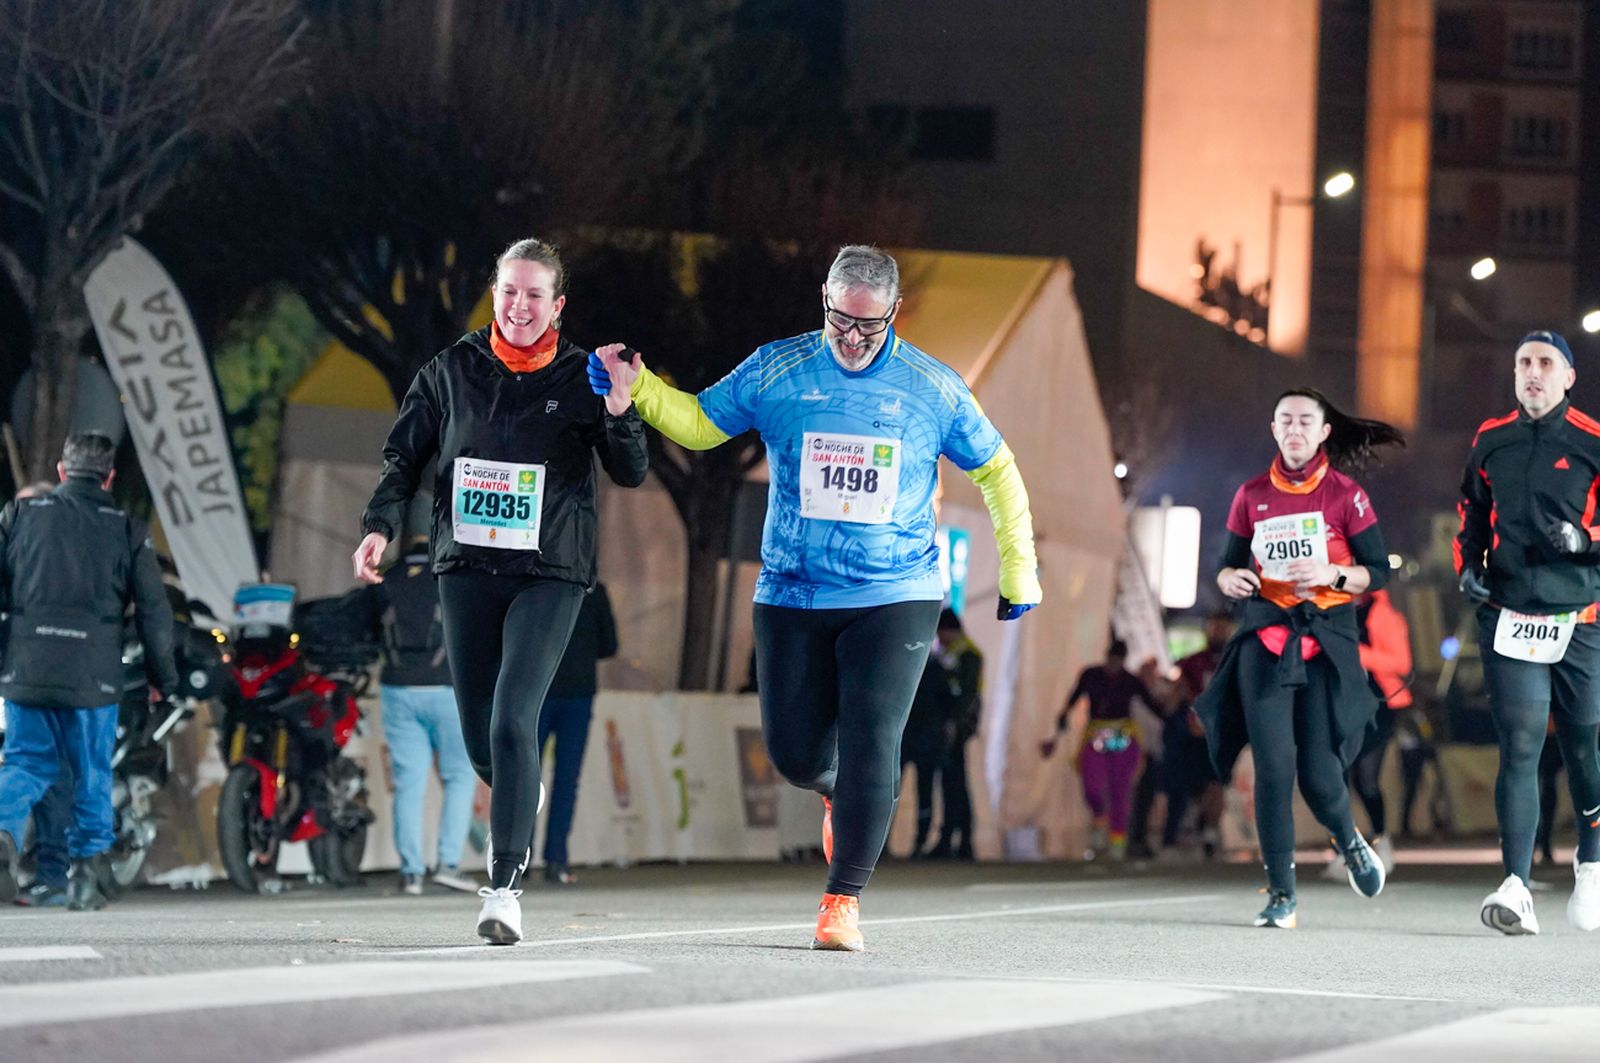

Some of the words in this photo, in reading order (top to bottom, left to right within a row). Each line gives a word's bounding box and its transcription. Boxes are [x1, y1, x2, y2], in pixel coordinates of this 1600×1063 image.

[108, 297, 194, 527] DACIA
[141, 290, 235, 515] JAPEMASA
[812, 452, 832, 463] SAN
[832, 454, 865, 465] ANTÓN
[824, 443, 852, 454] NOCHE
[853, 446, 865, 455] DE
[463, 478, 478, 488] SAN
[479, 480, 511, 492] ANTÓN
[472, 469, 498, 480] NOCHE
[499, 472, 511, 482] DE
[820, 465, 879, 493] 1498
[462, 490, 531, 520] 12935
[1265, 538, 1313, 561] 2905
[1511, 622, 1560, 641] 2904
